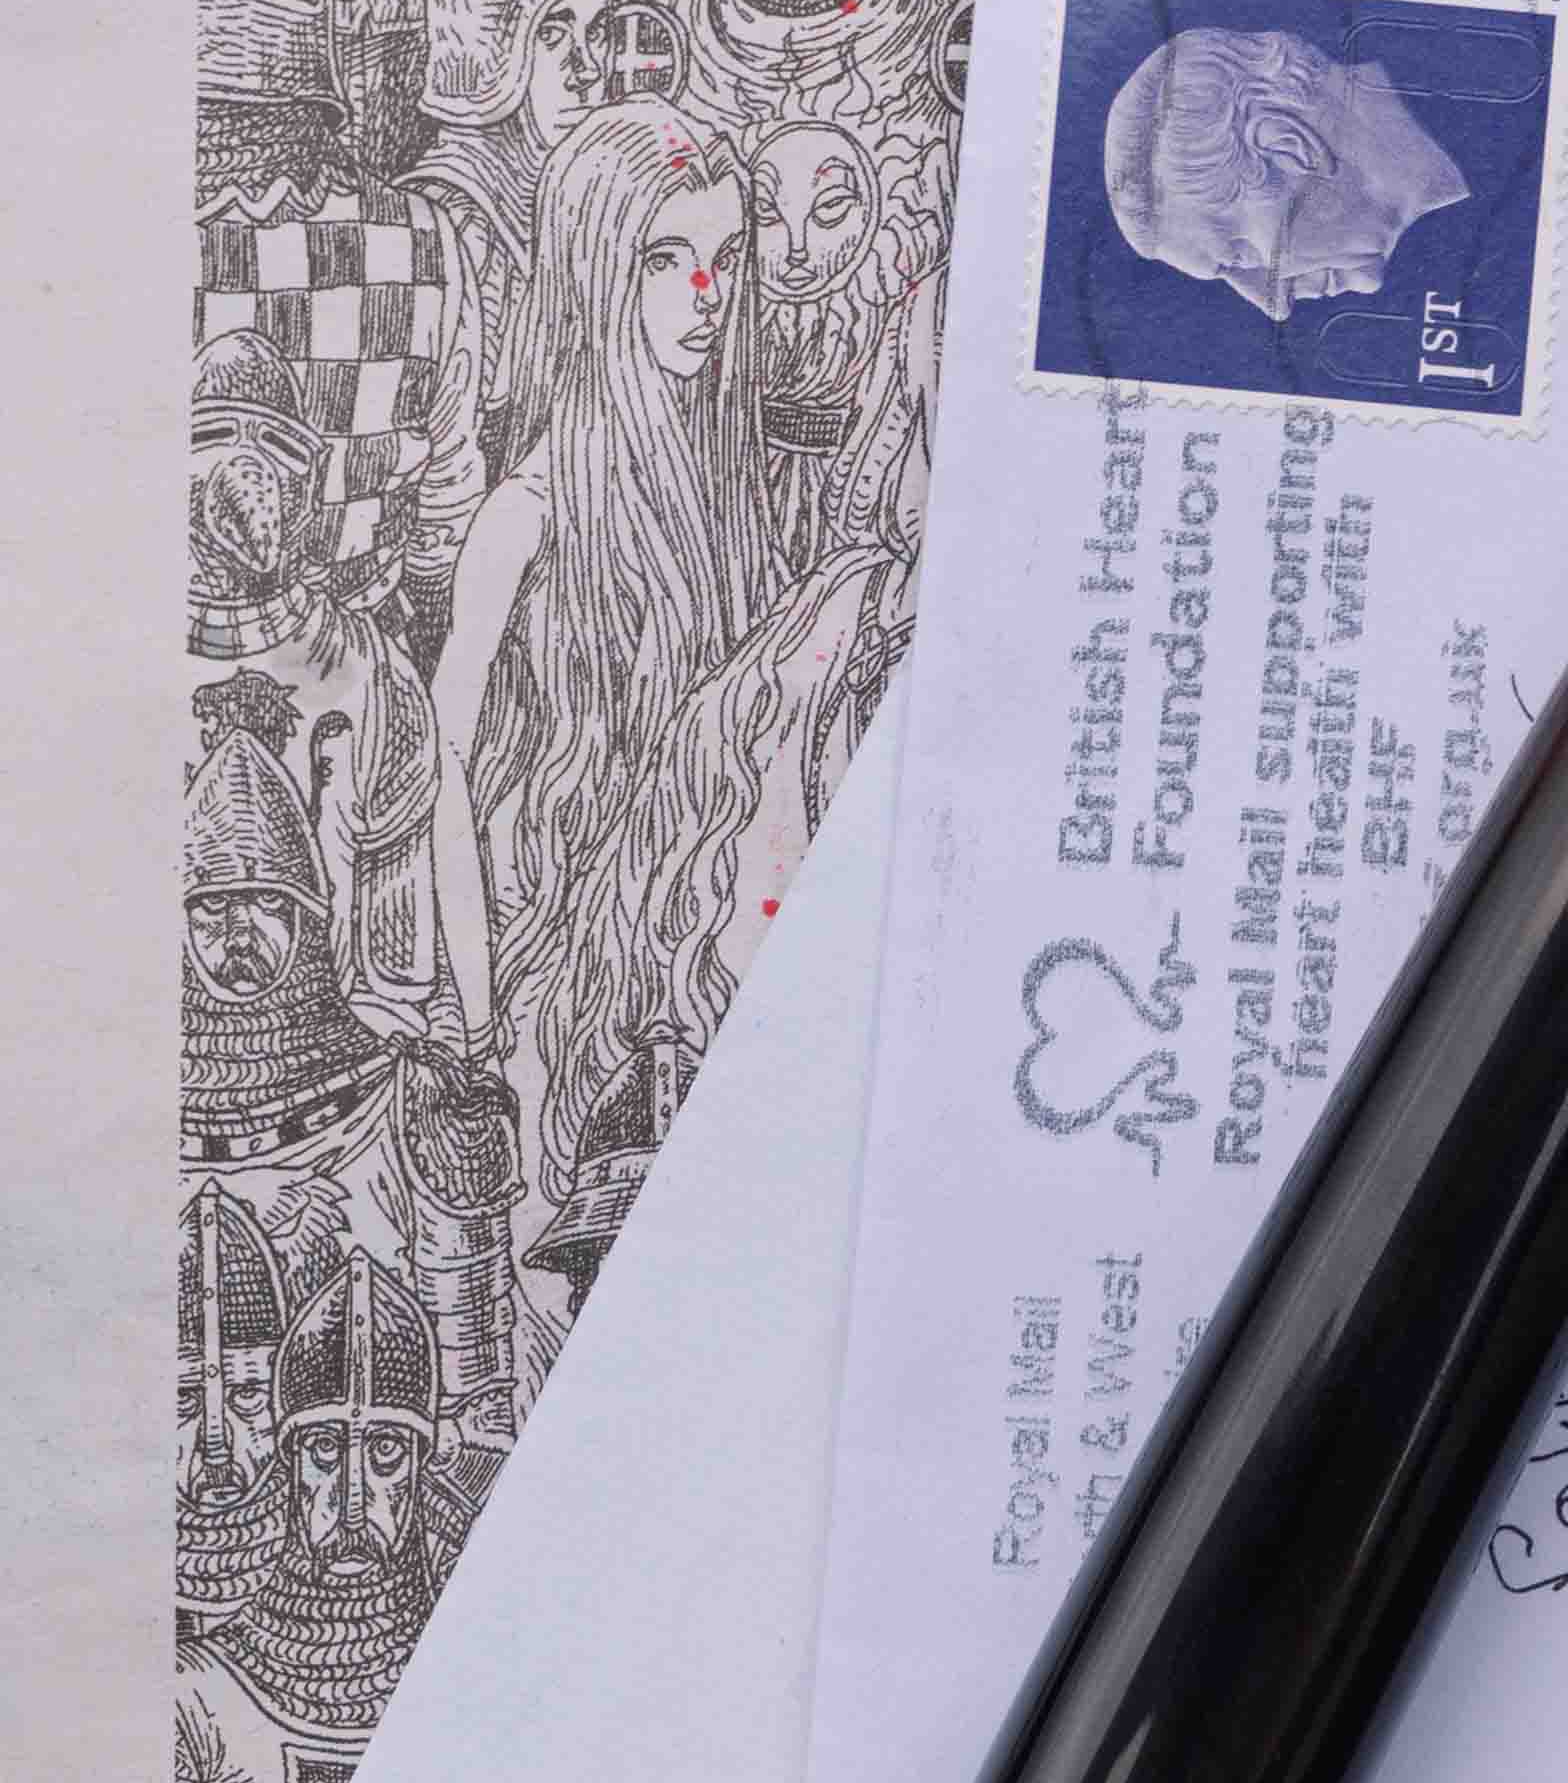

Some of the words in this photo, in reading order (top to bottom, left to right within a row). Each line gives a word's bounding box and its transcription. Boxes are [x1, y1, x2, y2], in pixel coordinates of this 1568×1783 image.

[1079, 378, 1150, 594] Heart
[1324, 493, 1375, 648] with
[1133, 430, 1221, 869] Foundation
[1254, 403, 1334, 783] supporting
[1057, 616, 1131, 867] British
[1297, 666, 1361, 881] health
[1231, 806, 1289, 946] Mail
[1214, 965, 1290, 1168] Royal
[1288, 888, 1343, 1082] heart
[1006, 1294, 1063, 1398] Mail
[1084, 1252, 1144, 1400] West
[991, 1417, 1062, 1571] Royal
